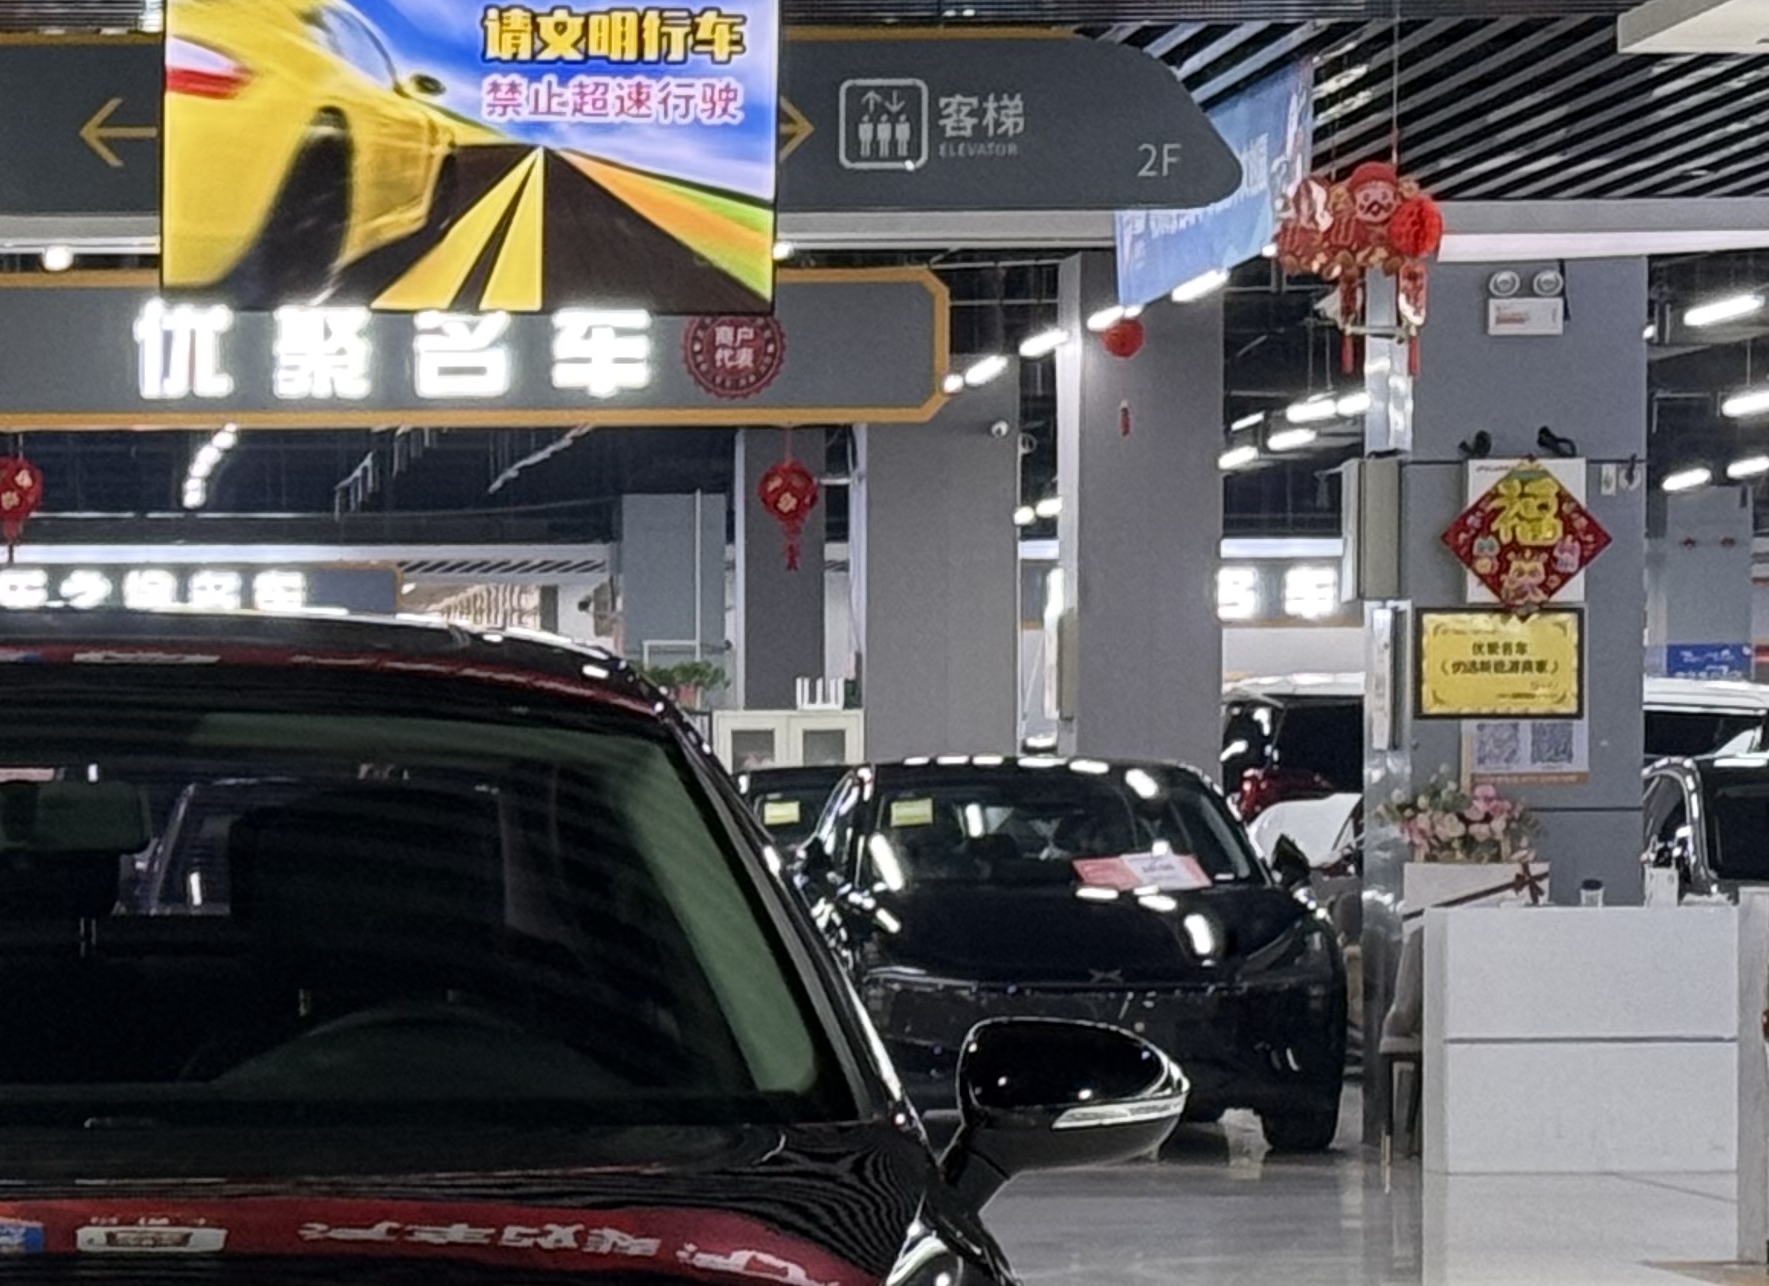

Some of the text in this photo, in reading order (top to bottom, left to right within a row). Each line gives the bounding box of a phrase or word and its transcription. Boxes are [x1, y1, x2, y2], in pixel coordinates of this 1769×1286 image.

[482, 6, 747, 64] 请文明行车
[485, 79, 739, 120] 禁止超速行驶
[938, 93, 1025, 138] 客梯
[939, 142, 1018, 157] ELEVATOR
[1137, 144, 1181, 176] 2F
[133, 298, 651, 399] 优聚名车
[715, 326, 754, 346] 商户
